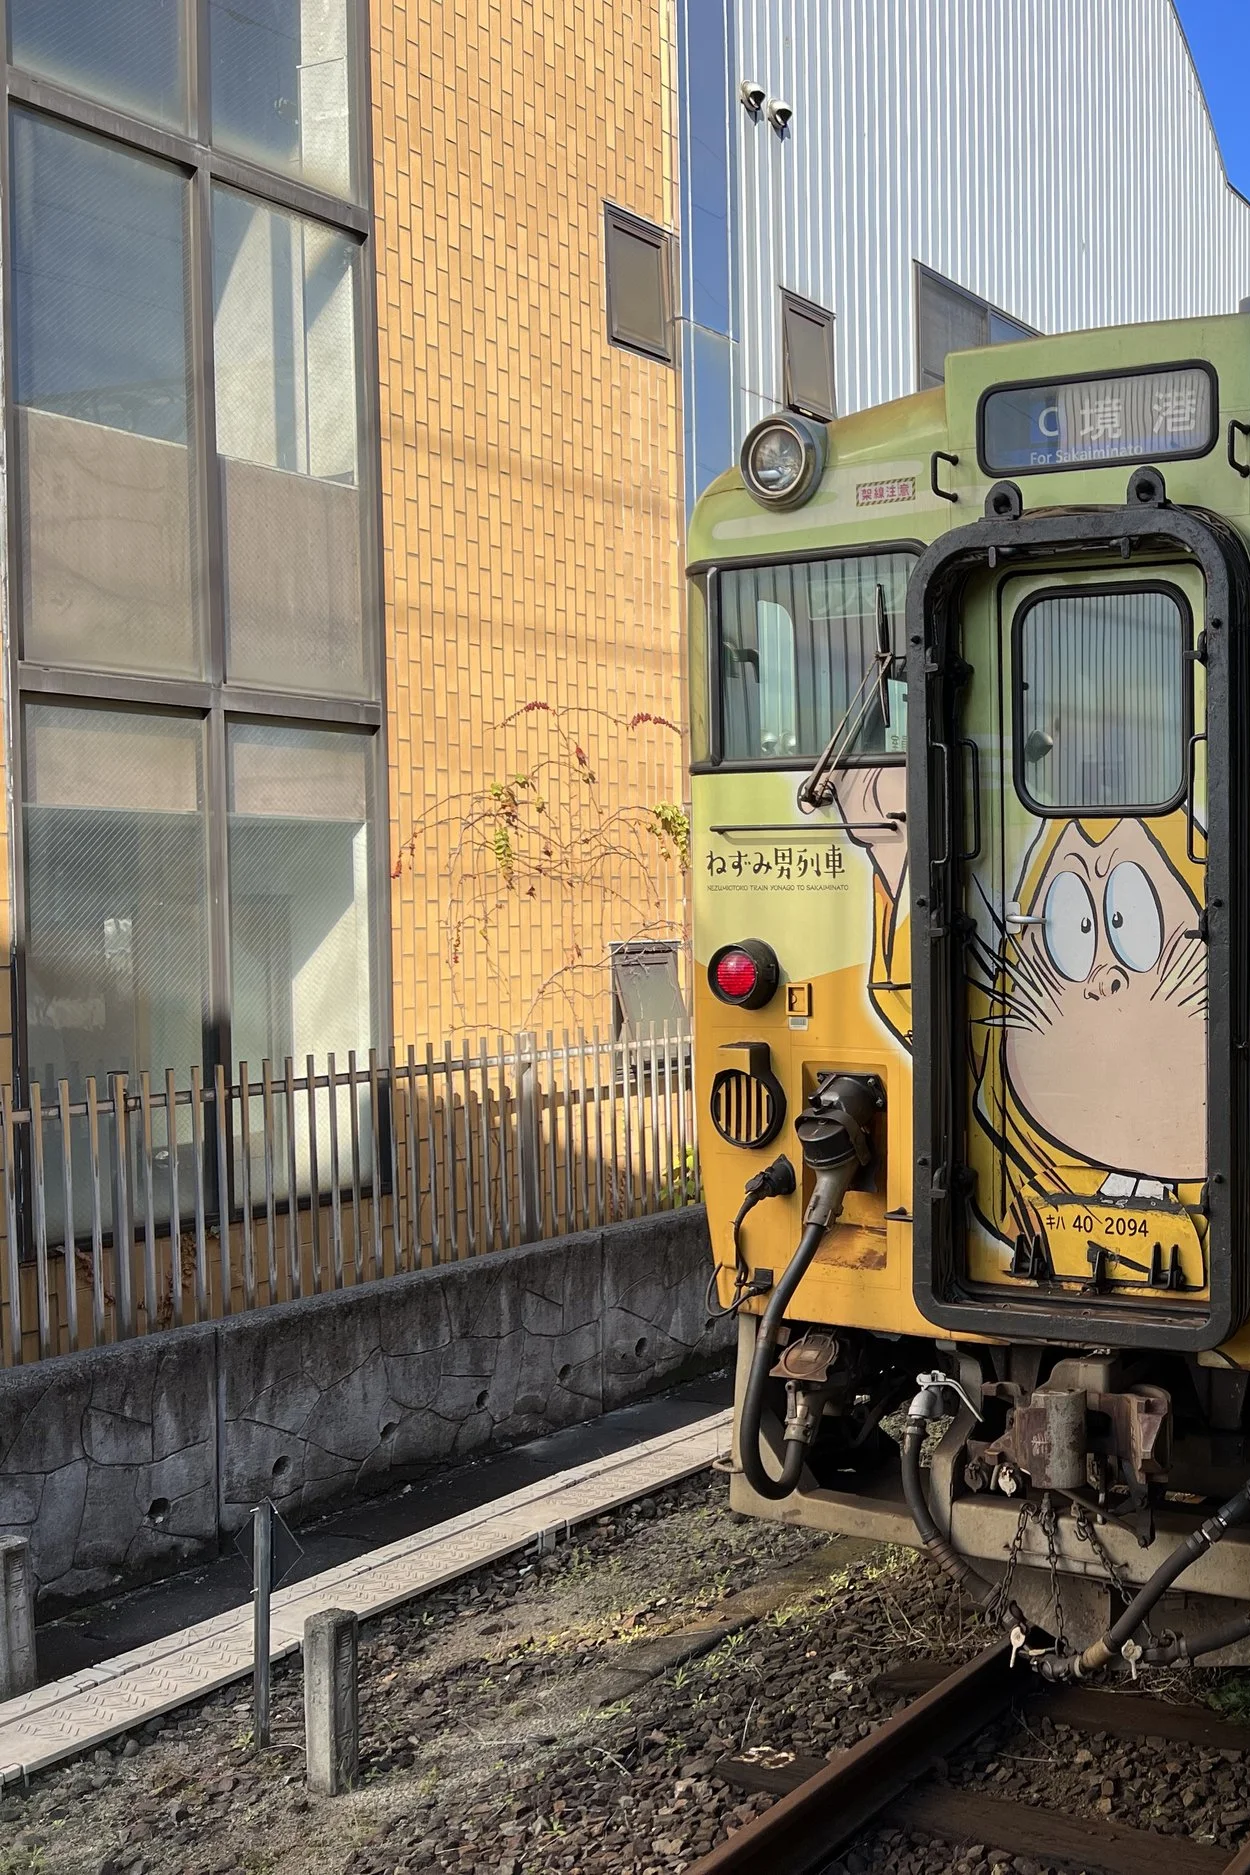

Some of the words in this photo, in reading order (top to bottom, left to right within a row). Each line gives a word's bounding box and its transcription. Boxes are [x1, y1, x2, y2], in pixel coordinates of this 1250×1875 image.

[1080, 390, 1197, 440] 境港
[1030, 451, 1053, 465] For
[1056, 443, 1143, 465] Sakaiminato
[861, 483, 910, 501] 架線注意
[706, 844, 846, 880] ねずみ男列車
[750, 884, 769, 892] TRAIN
[770, 884, 795, 892] YONAGO
[797, 884, 805, 892] TO
[806, 884, 849, 892] SAKAIMINATO
[1046, 1214, 1066, 1231] キハ
[1072, 1214, 1094, 1234] 40
[1104, 1216, 1149, 1238] 2094
